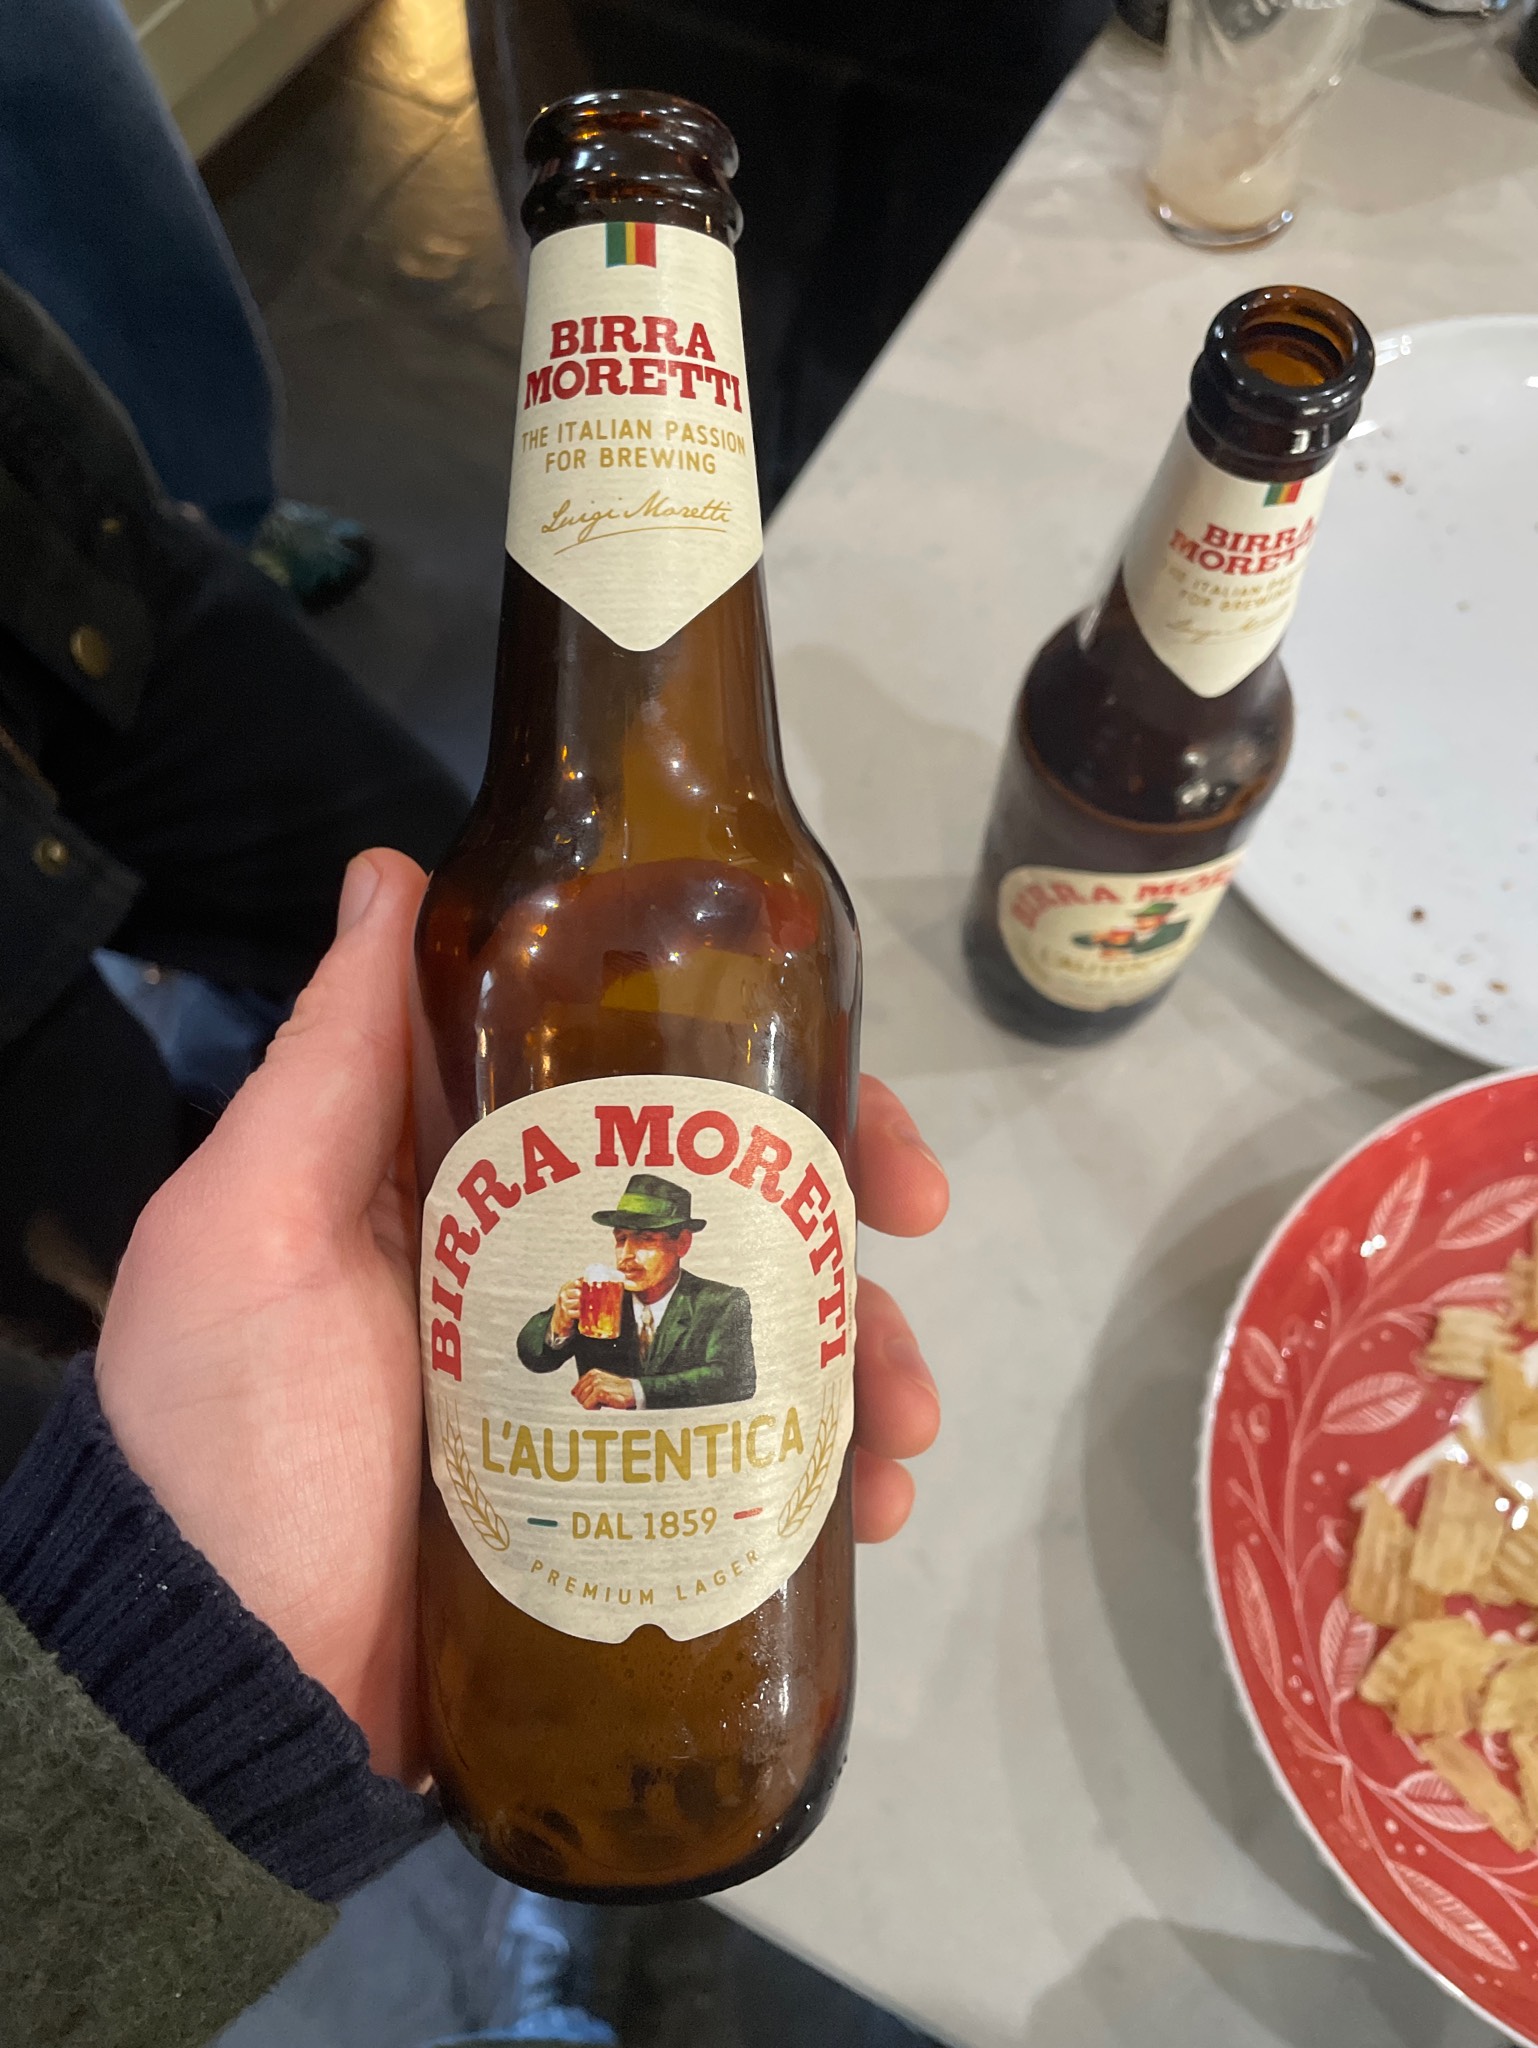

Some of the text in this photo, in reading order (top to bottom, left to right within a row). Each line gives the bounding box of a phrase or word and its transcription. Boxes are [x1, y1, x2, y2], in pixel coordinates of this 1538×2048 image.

[550, 315, 716, 363] BIRRA
[523, 357, 743, 414] MORETTI
[521, 418, 747, 457] THE ITALIAN PASSION
[545, 446, 717, 475] FOR BREWING
[431, 1104, 848, 1383] BIRRA MORETTI
[481, 1406, 805, 1484] L'AUTENTICA
[571, 1506, 718, 1541] DAL 1859
[530, 1549, 759, 1606] PREMIUM LAGER
